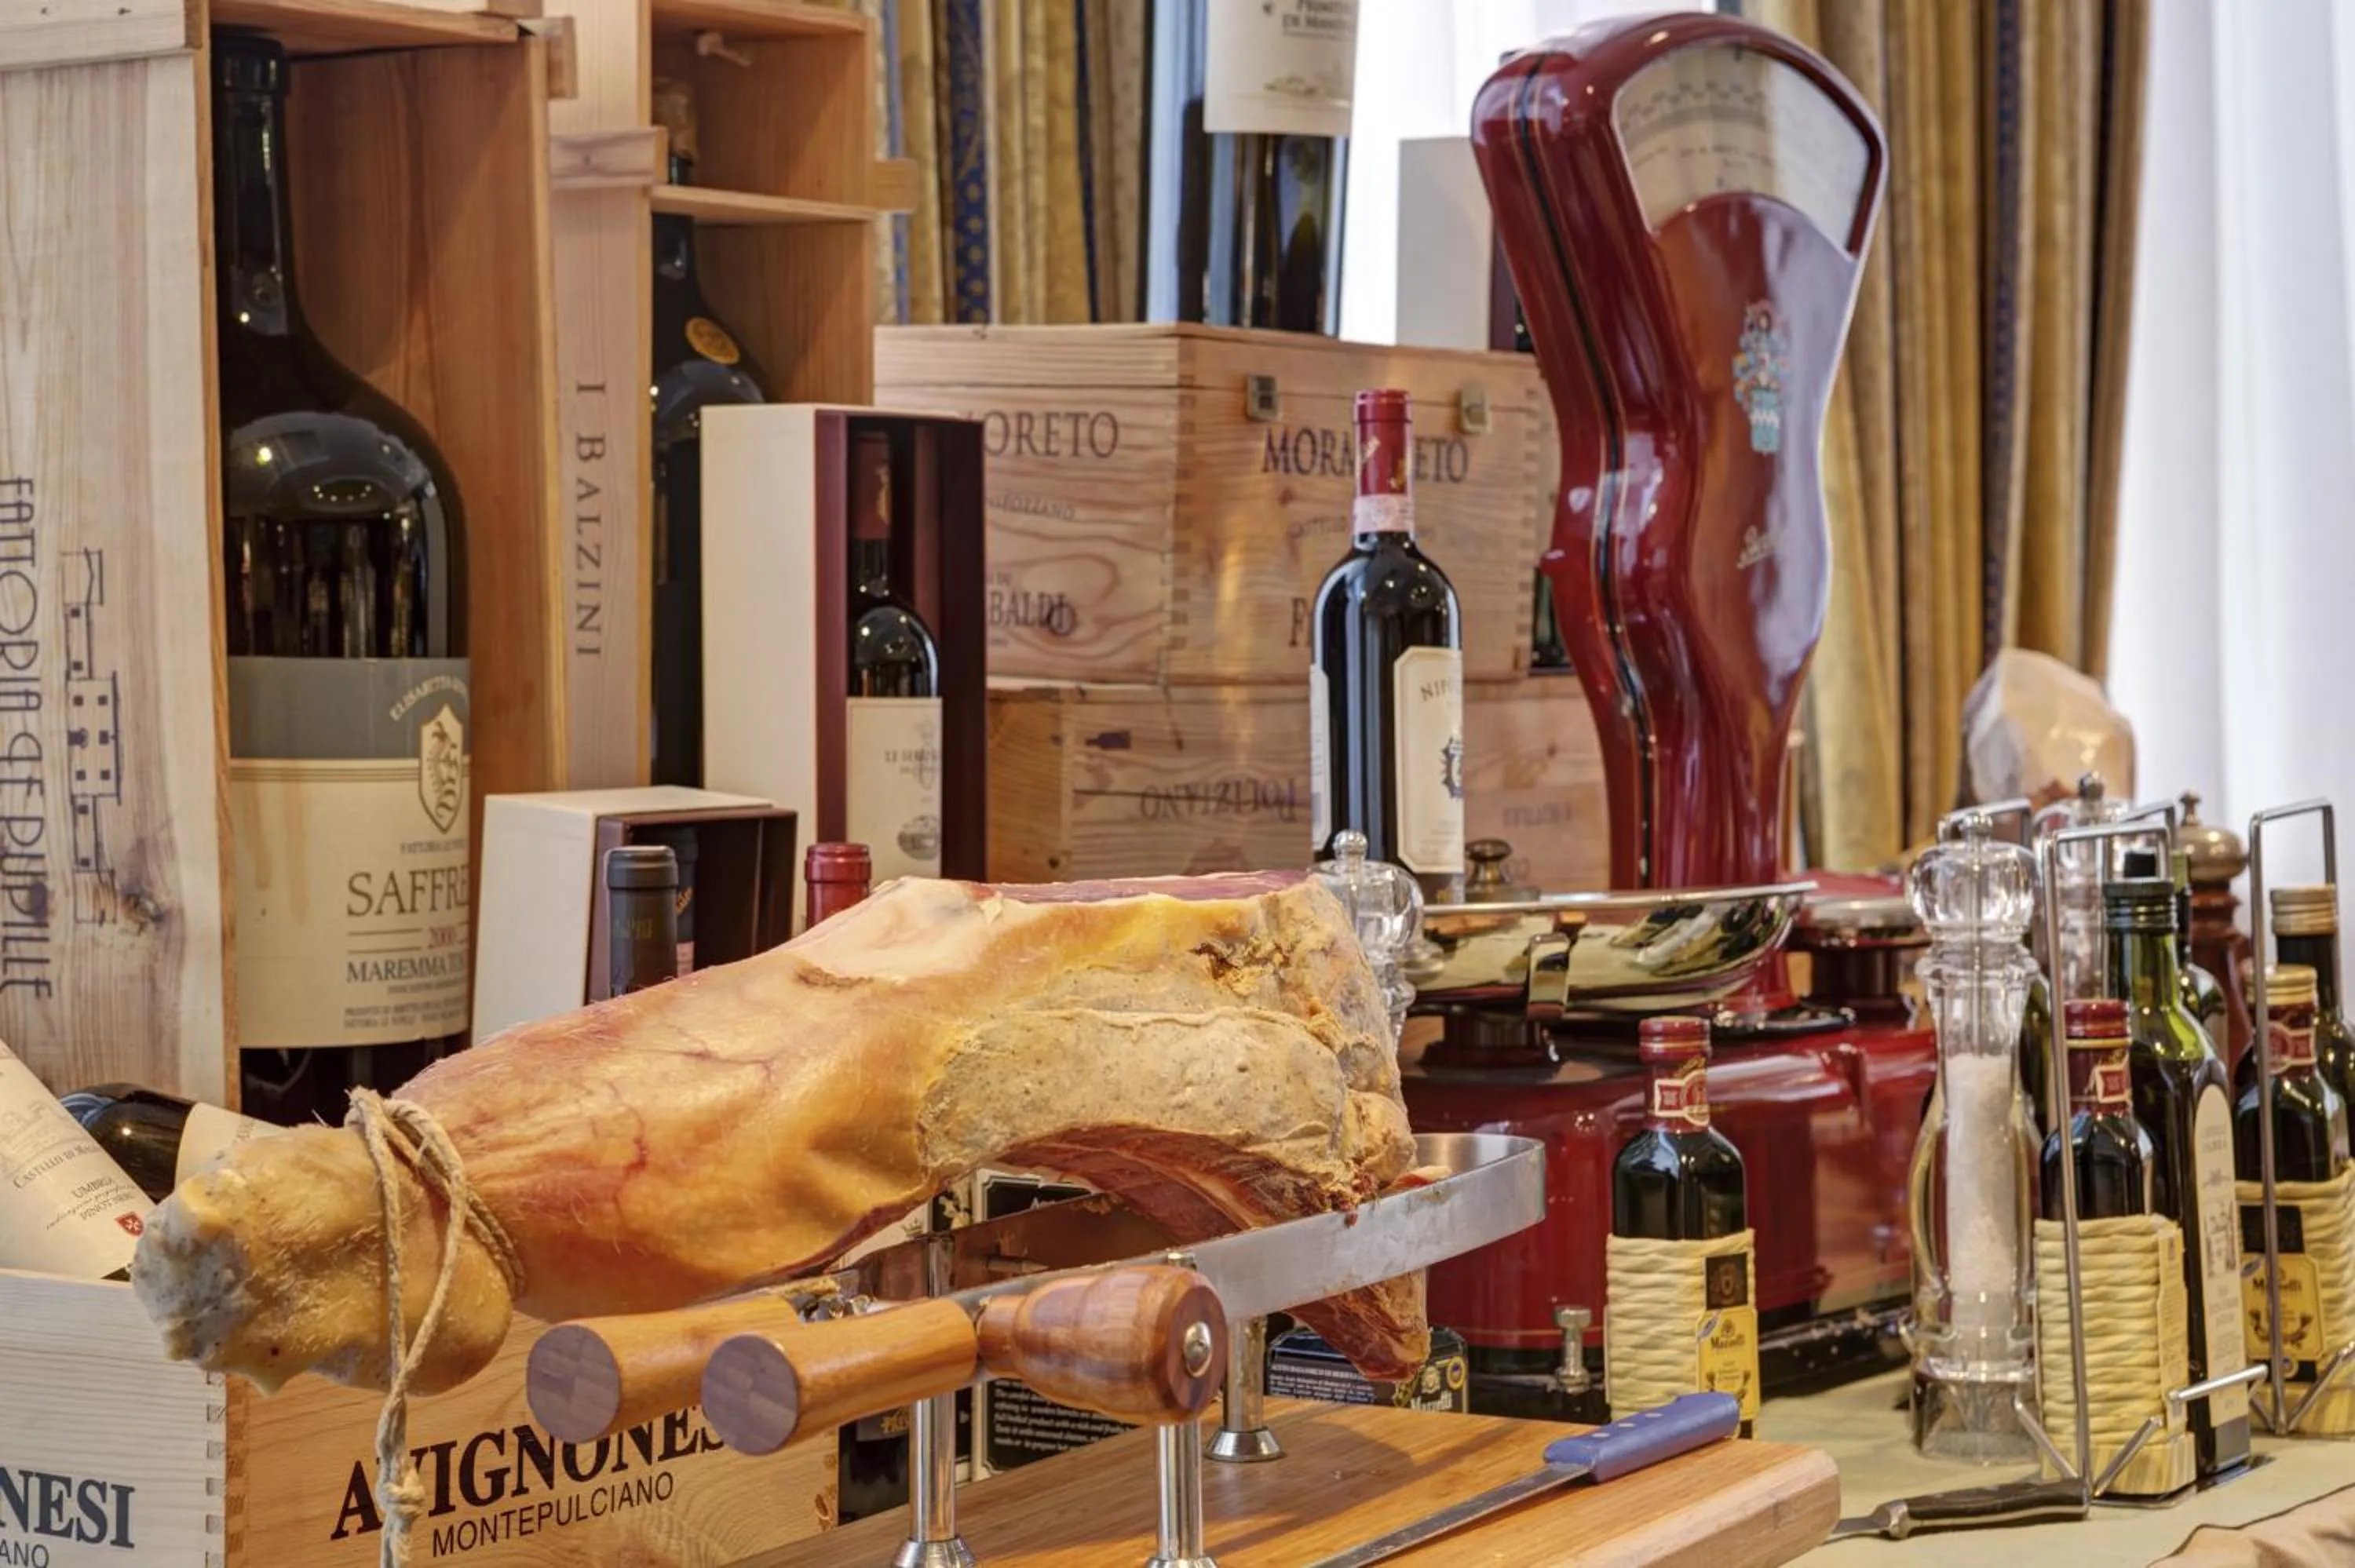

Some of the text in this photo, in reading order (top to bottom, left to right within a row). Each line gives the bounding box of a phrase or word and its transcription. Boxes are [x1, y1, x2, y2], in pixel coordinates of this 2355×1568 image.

[983, 410, 1119, 458] ORETO
[575, 381, 605, 658] I BALZINI
[0, 477, 42, 712] FATTORIA
[346, 954, 447, 983] MAREMMA
[432, 1471, 674, 1558] MONTEPULCIANO
